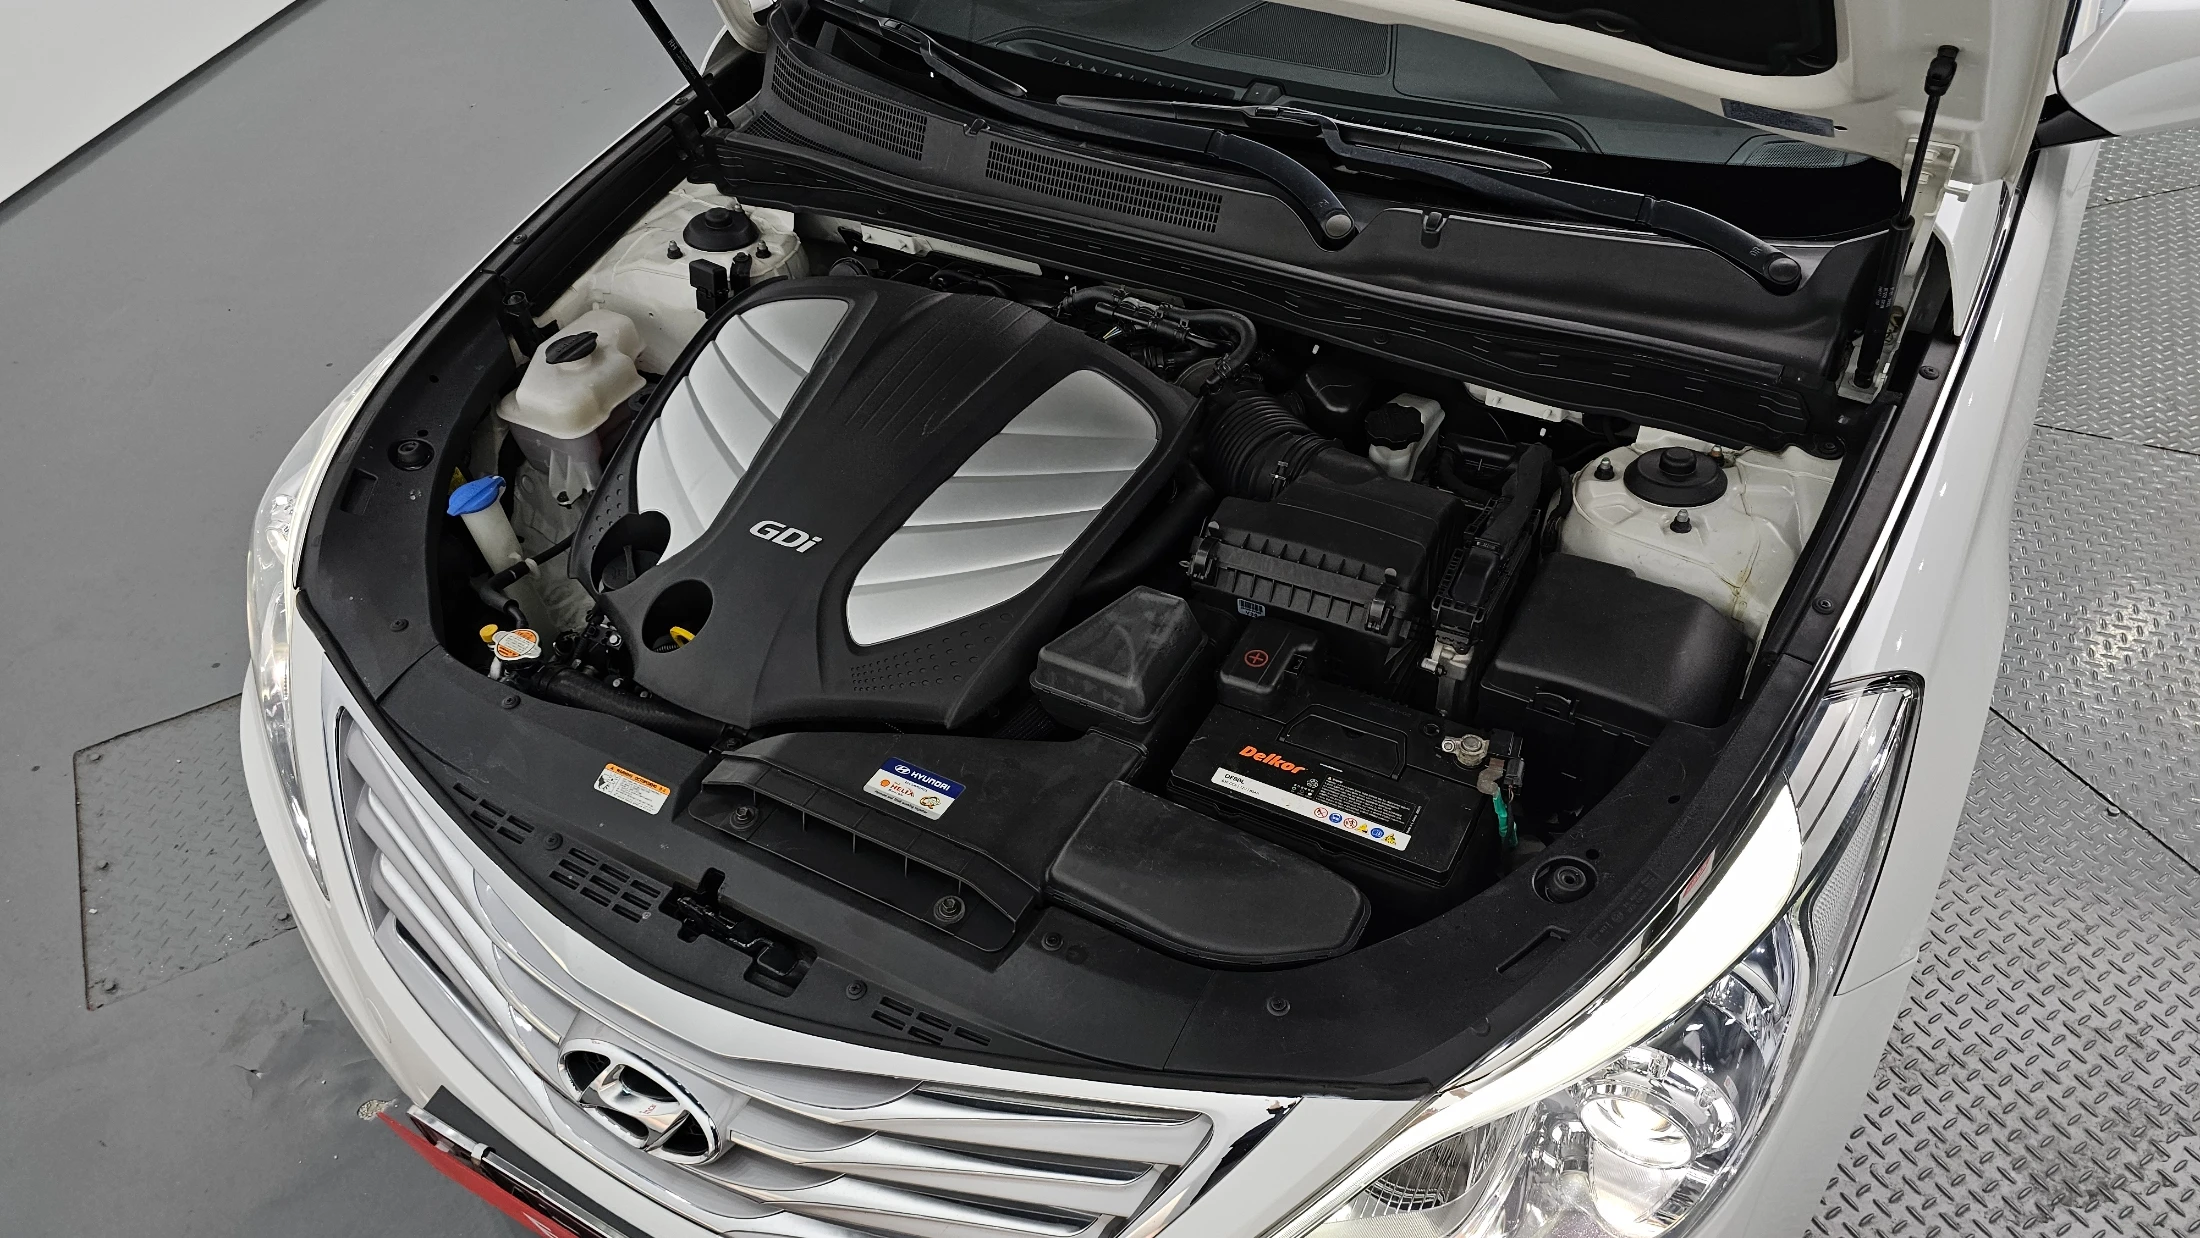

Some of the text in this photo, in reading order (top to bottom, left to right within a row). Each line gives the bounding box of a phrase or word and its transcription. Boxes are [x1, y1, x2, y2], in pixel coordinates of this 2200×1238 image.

[749, 520, 823, 553] GDi
[1239, 745, 1306, 774] Delkor
[890, 784, 915, 798] HELIX
[910, 770, 951, 792] HYUNDAI
